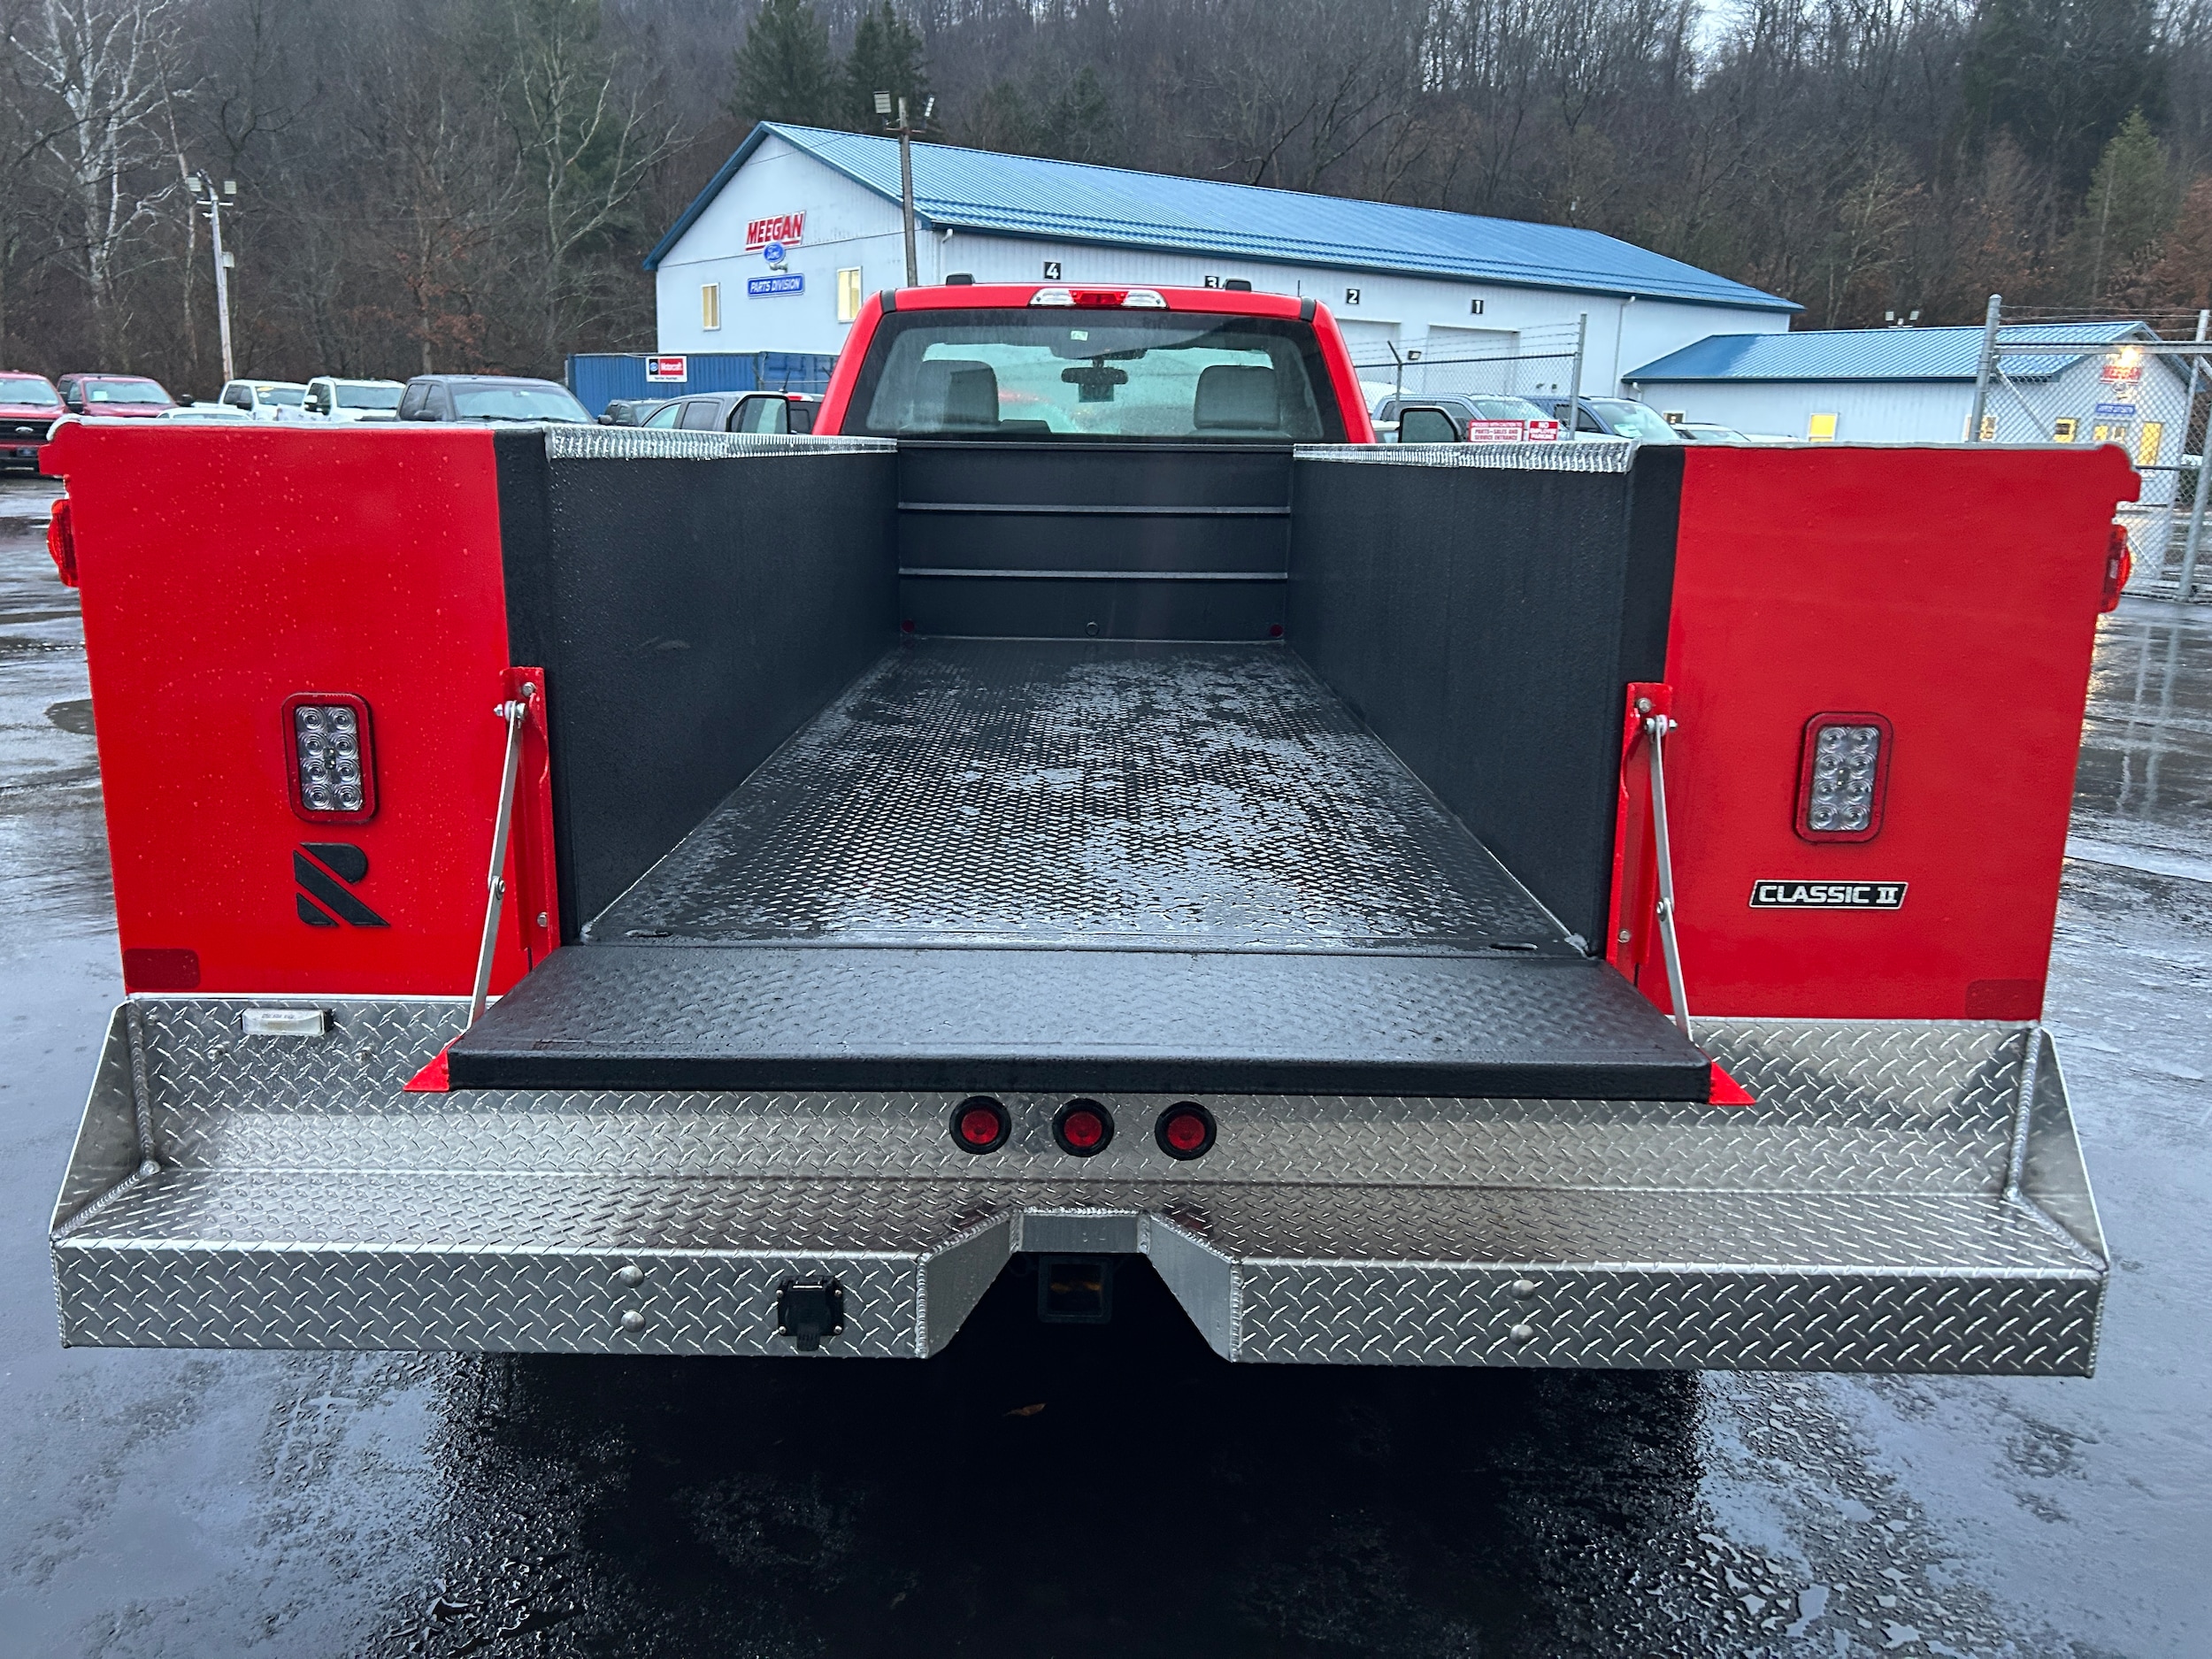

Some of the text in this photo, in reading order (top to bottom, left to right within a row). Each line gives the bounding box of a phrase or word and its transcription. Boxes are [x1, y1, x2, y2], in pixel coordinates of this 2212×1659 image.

[746, 213, 803, 245] MEEGAN
[1046, 263, 1059, 279] 4
[749, 277, 801, 293] PARTS DIVISION
[1207, 277, 1217, 288] 3
[1348, 289, 1358, 303] 2
[1475, 300, 1480, 314] 1
[1758, 885, 1899, 904] CLASSIC II
